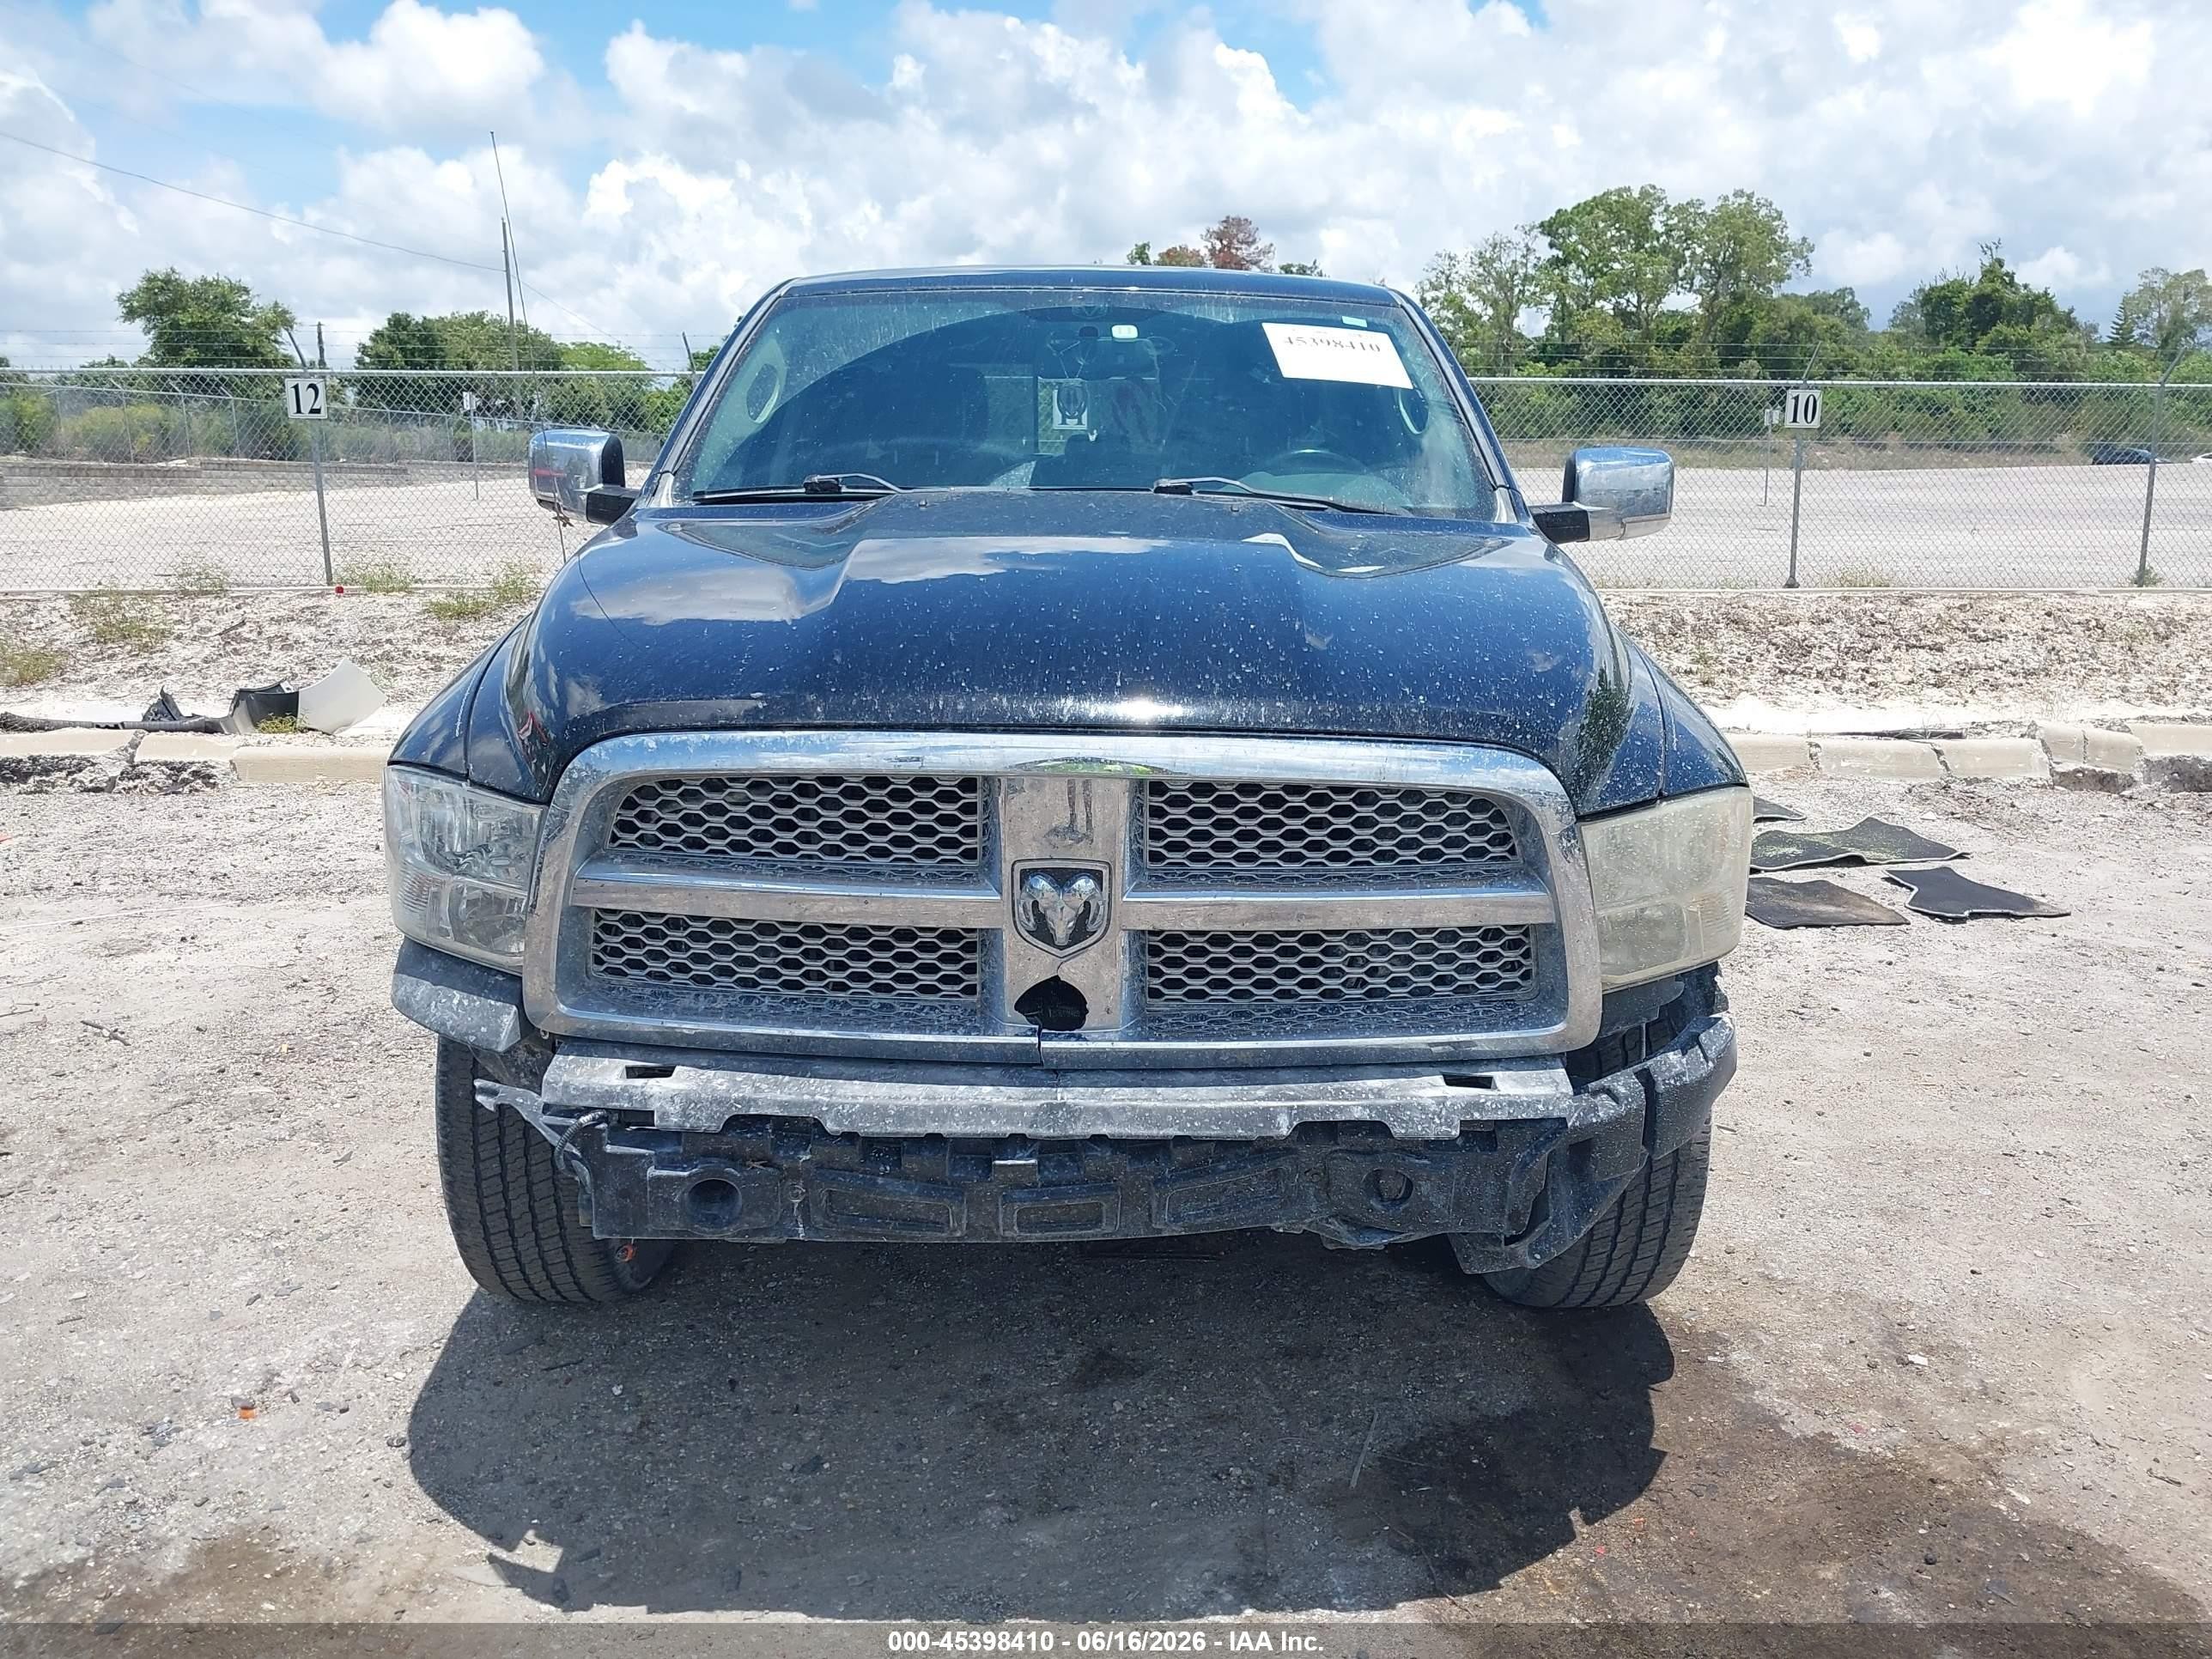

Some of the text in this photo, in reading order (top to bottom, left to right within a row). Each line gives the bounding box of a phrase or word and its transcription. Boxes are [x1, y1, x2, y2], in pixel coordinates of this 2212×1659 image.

[1284, 336, 1381, 353] 45398410
[289, 382, 322, 415] 12
[1789, 393, 1818, 424] 10
